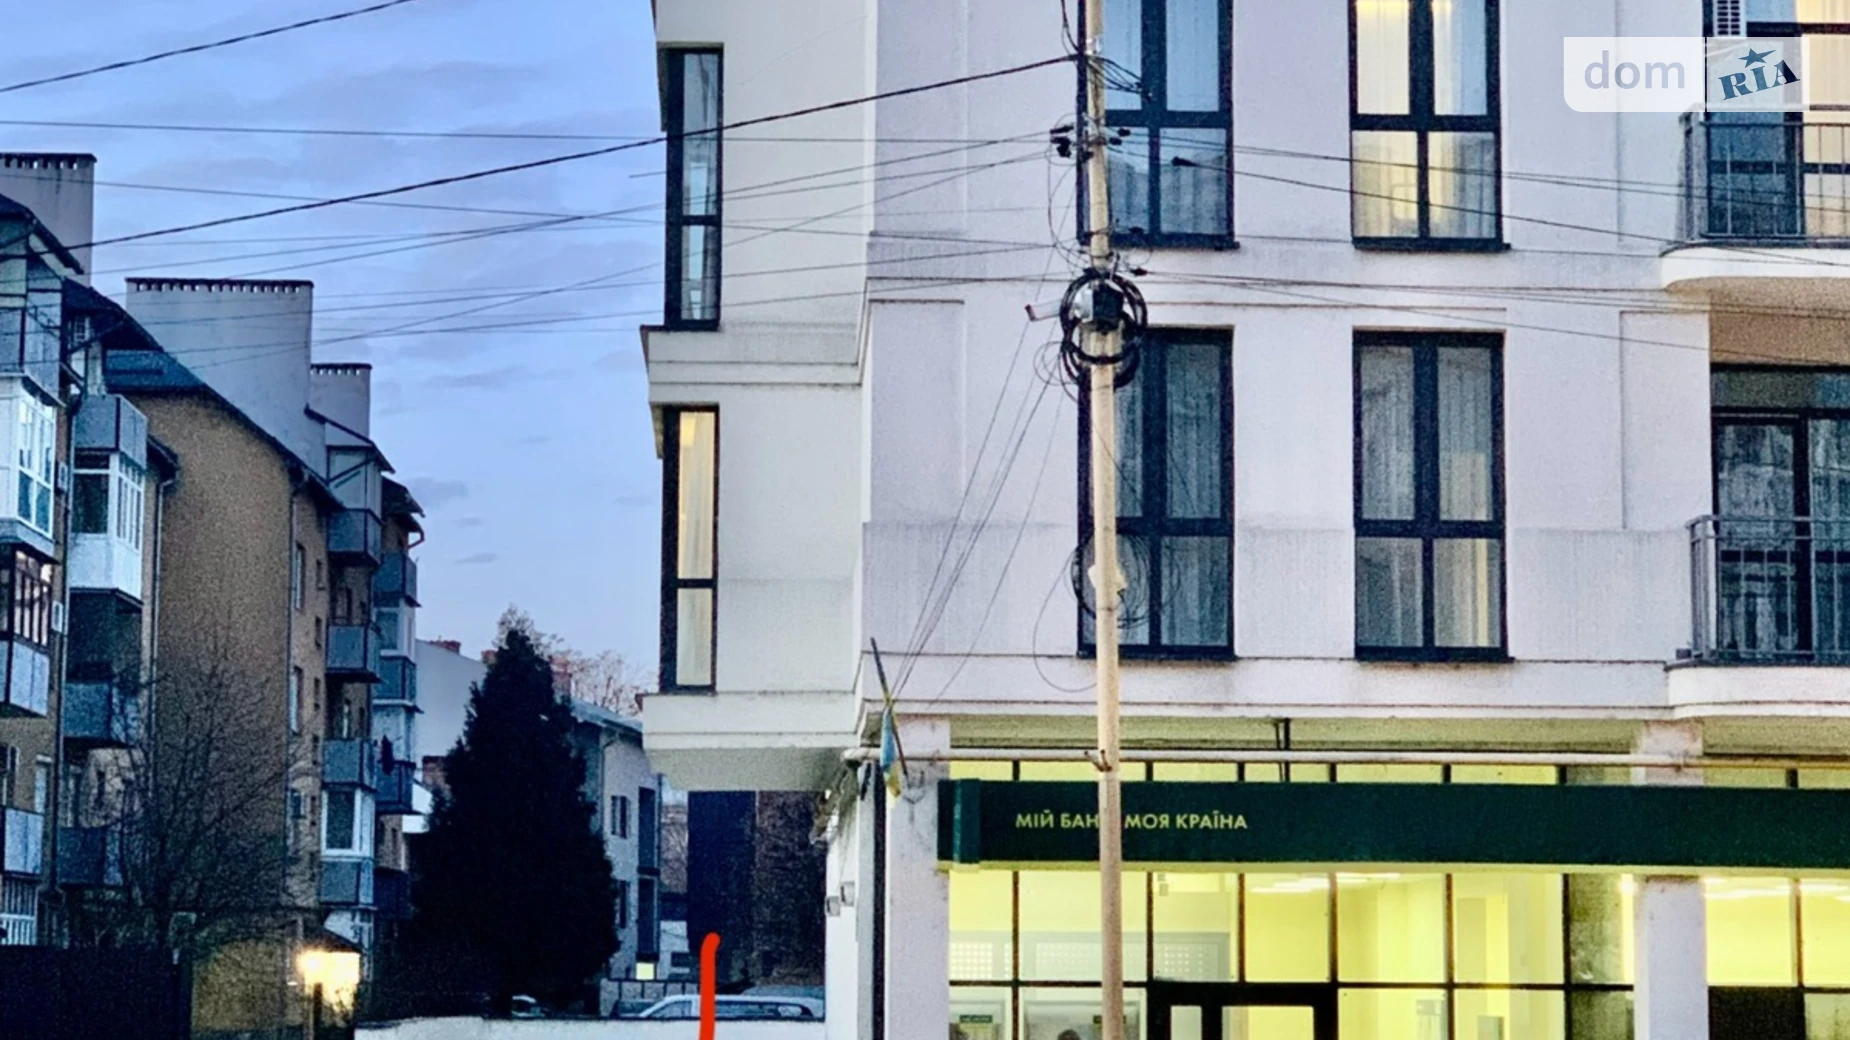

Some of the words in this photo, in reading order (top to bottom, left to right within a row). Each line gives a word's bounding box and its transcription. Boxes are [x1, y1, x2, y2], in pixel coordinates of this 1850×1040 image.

[1015, 809, 1054, 829] МІЙ
[1060, 813, 1099, 829] БАН
[1124, 813, 1169, 829] МОЯ
[1175, 809, 1248, 829] КРАЇНА
